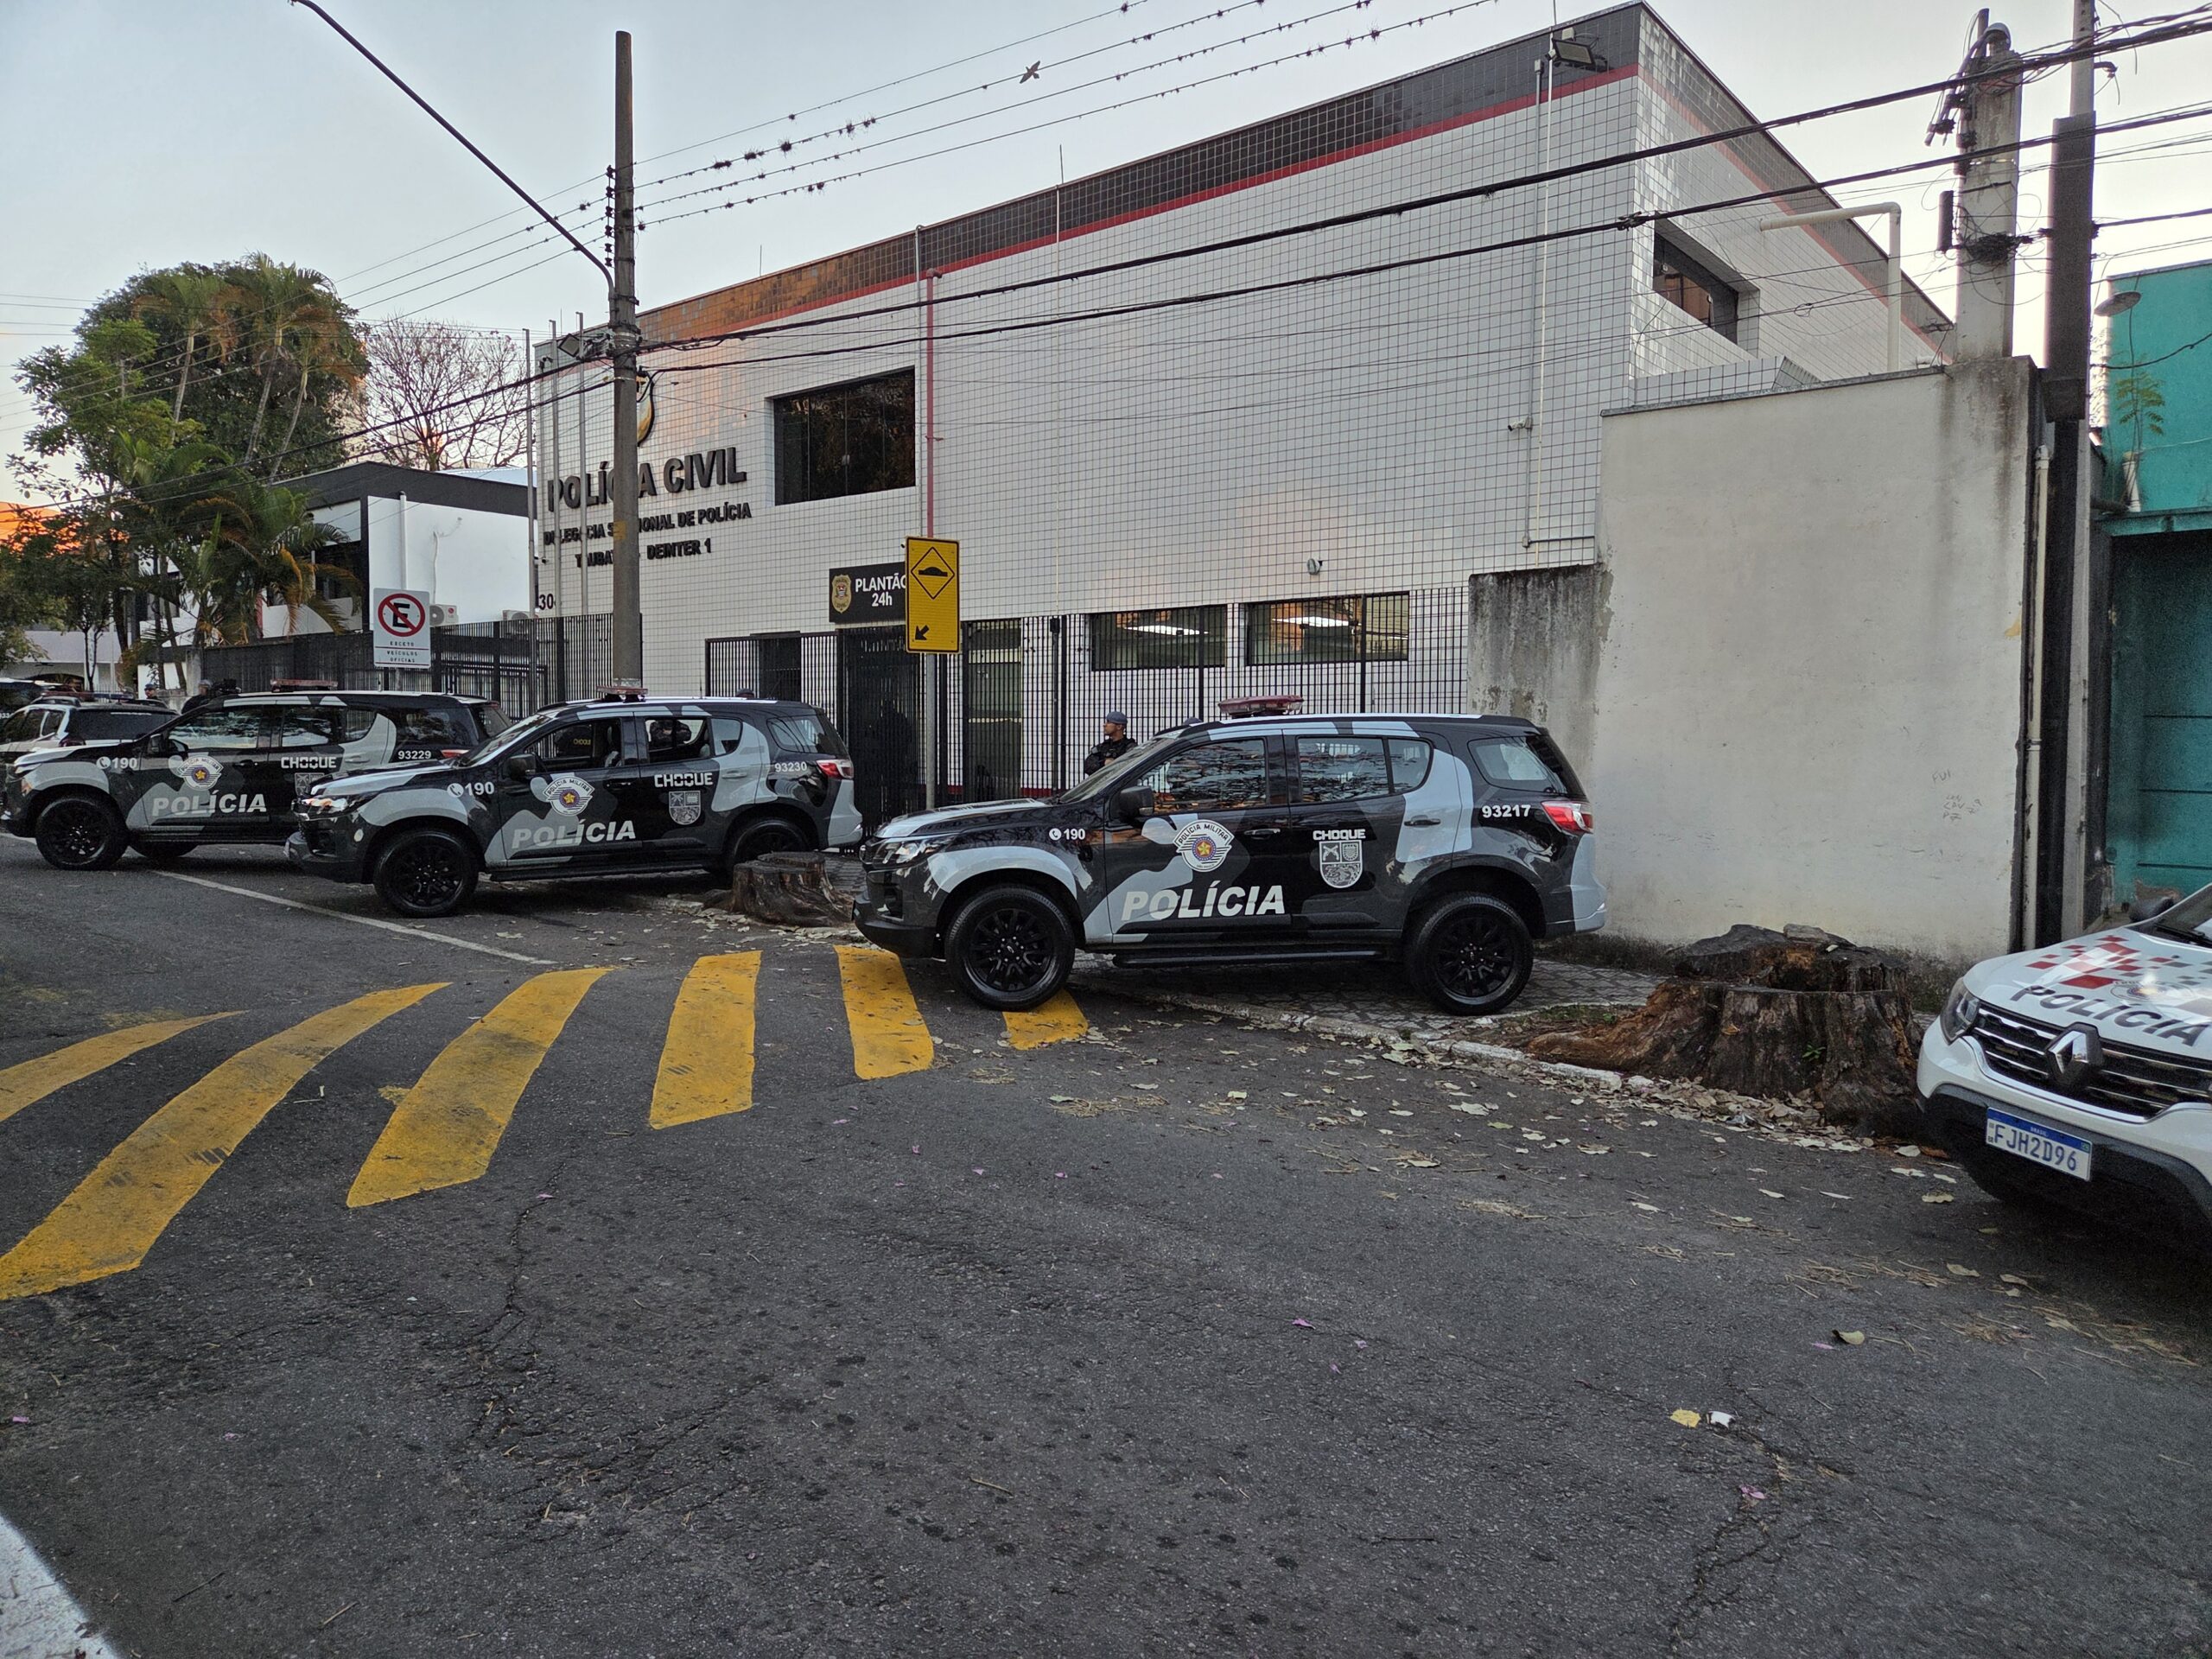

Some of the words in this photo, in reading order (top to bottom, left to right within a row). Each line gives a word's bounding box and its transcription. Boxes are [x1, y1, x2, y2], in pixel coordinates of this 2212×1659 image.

[547, 461, 658, 512] POLÍA
[664, 447, 747, 493] CIVIL
[677, 511, 696, 528] DE
[698, 502, 753, 524] POLÍCIA
[647, 539, 702, 560] DEINTER
[704, 537, 711, 553] 1
[871, 591, 893, 607] 24h
[392, 602, 410, 628] E
[111, 757, 137, 769] 190
[281, 756, 337, 770] CHOQUE
[397, 750, 432, 760] 93229
[774, 761, 808, 772] 93230
[654, 772, 714, 788] CHOQUE
[465, 781, 495, 796] 190
[151, 790, 267, 817] POLÍCIA
[1481, 804, 1531, 818] 93217
[512, 819, 636, 849] POLÍCIA
[1063, 828, 1086, 841] 190
[1178, 823, 1201, 844] POLÍCIA
[1204, 823, 1229, 841] MILITAR
[1313, 829, 1366, 841] CHOQUE
[1121, 880, 1286, 922] POLÍCIA
[2010, 985, 2210, 1047] POLÍCIA
[2030, 1126, 2047, 1137] BRASIL
[1994, 1124, 2077, 1172] FJH2D96
